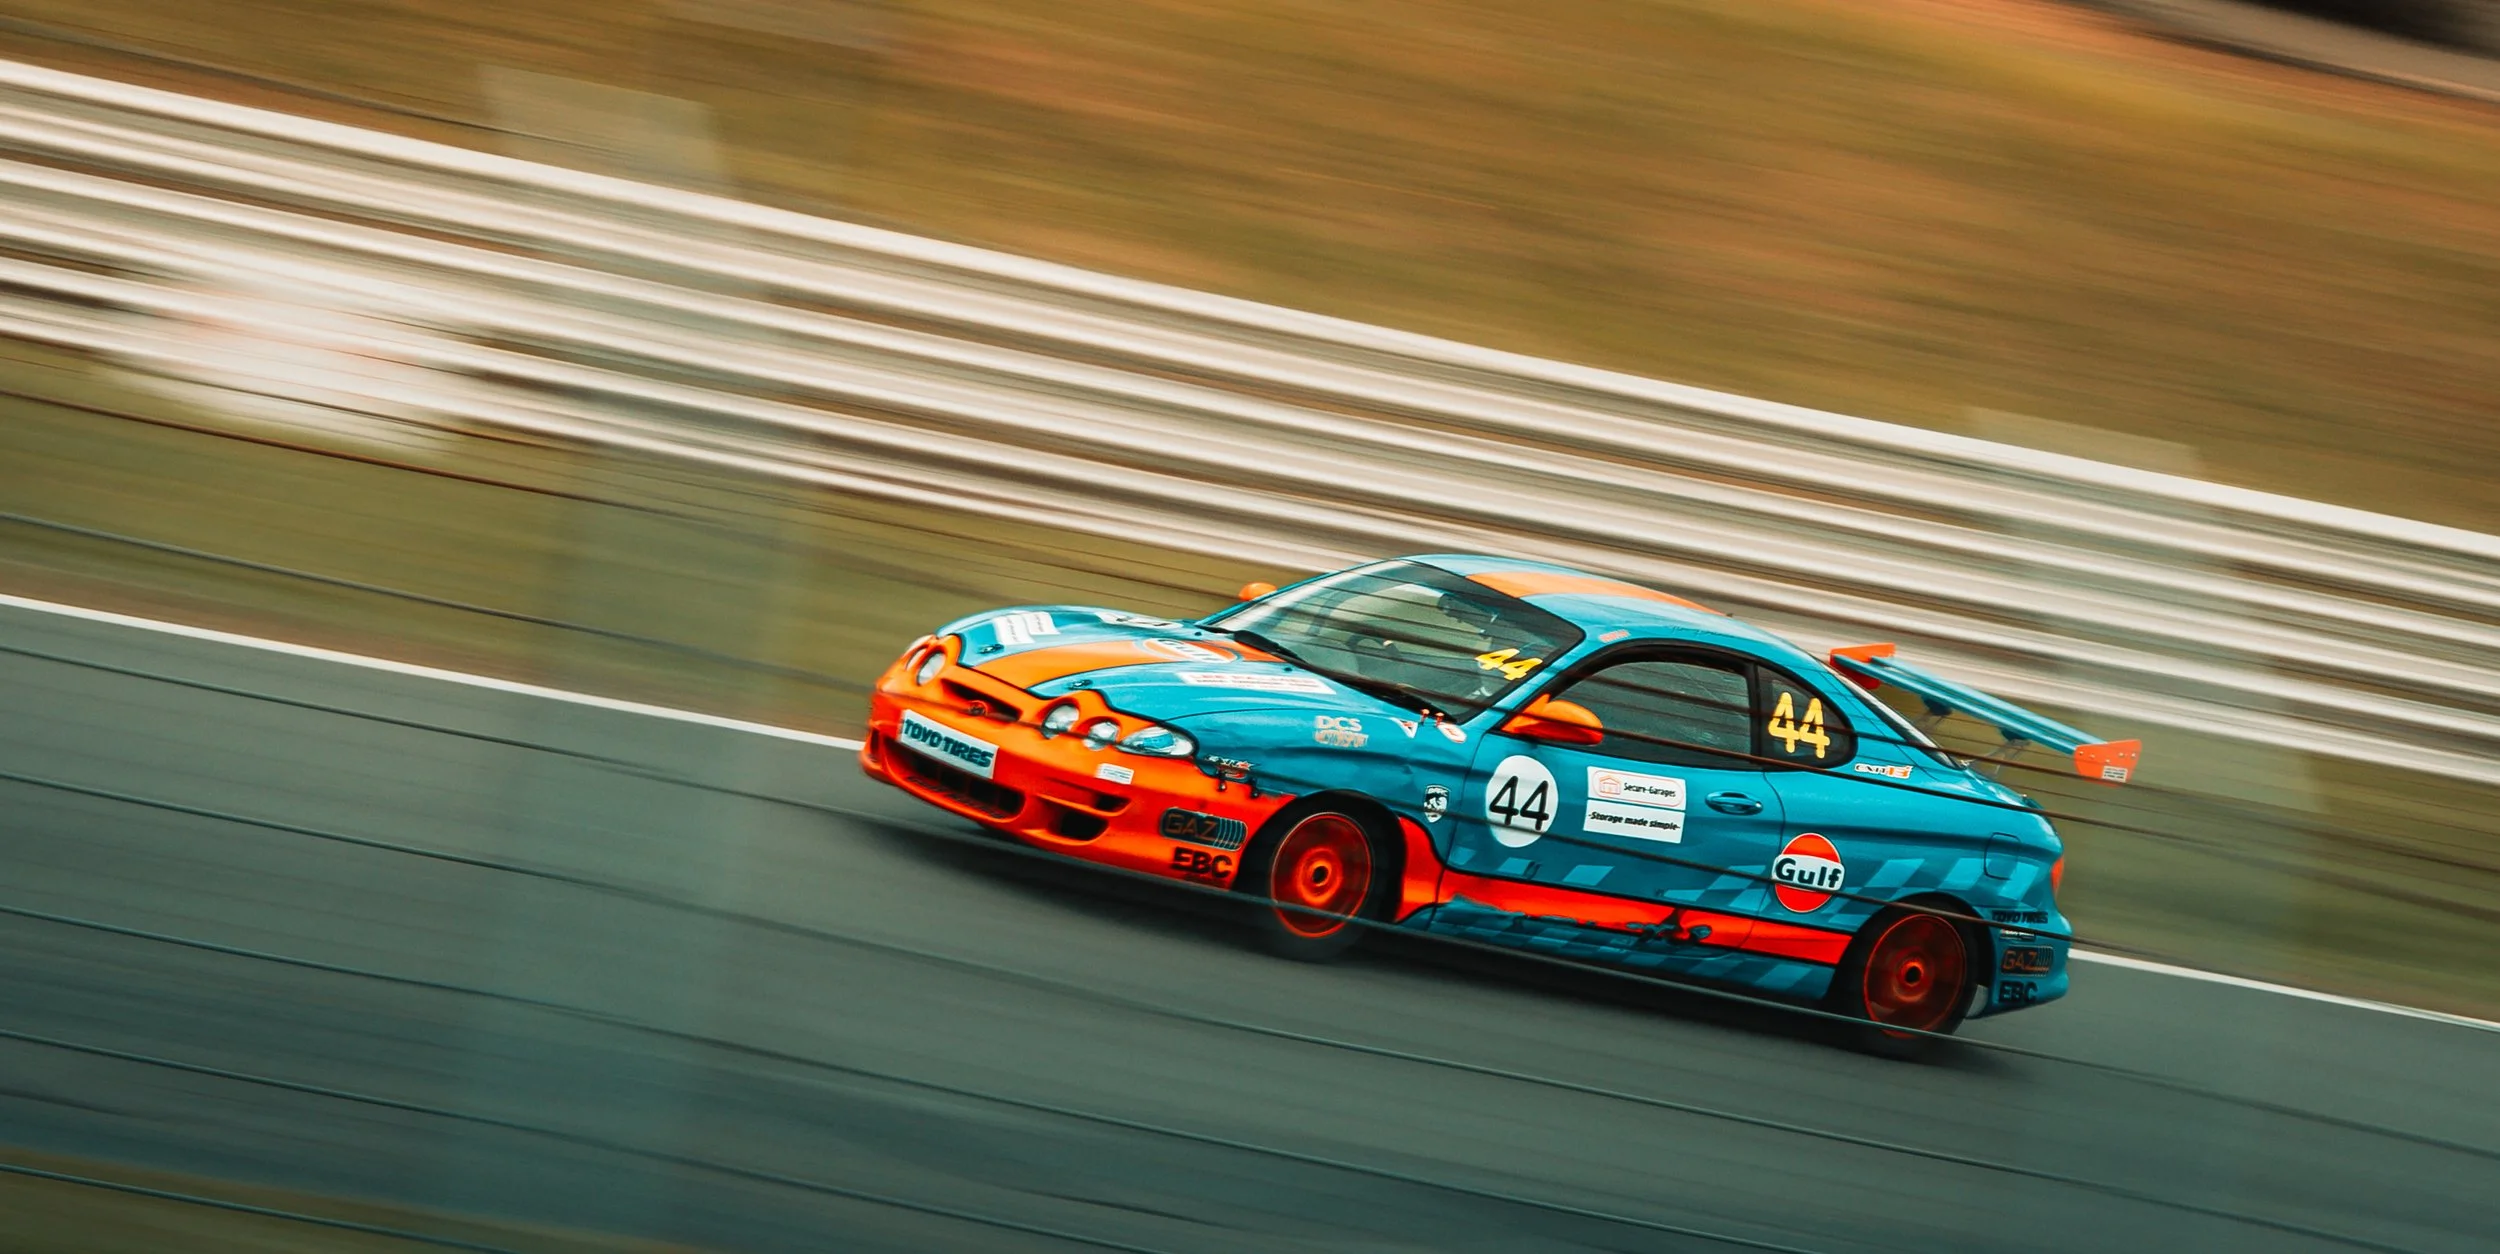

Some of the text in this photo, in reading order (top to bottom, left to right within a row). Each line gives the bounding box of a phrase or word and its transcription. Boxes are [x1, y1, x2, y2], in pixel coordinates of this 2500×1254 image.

[1475, 648, 1543, 681] 44
[1314, 715, 1362, 732] DCS
[1767, 692, 1831, 759] 44
[904, 718, 995, 768] TOYO TIRES
[1489, 775, 1549, 831] 44
[1165, 813, 1219, 842] GAZ
[1624, 817, 1648, 827] made
[1170, 846, 1233, 879] EBC
[1775, 857, 1842, 889] Gulf
[1998, 981, 2038, 1003] EBC
